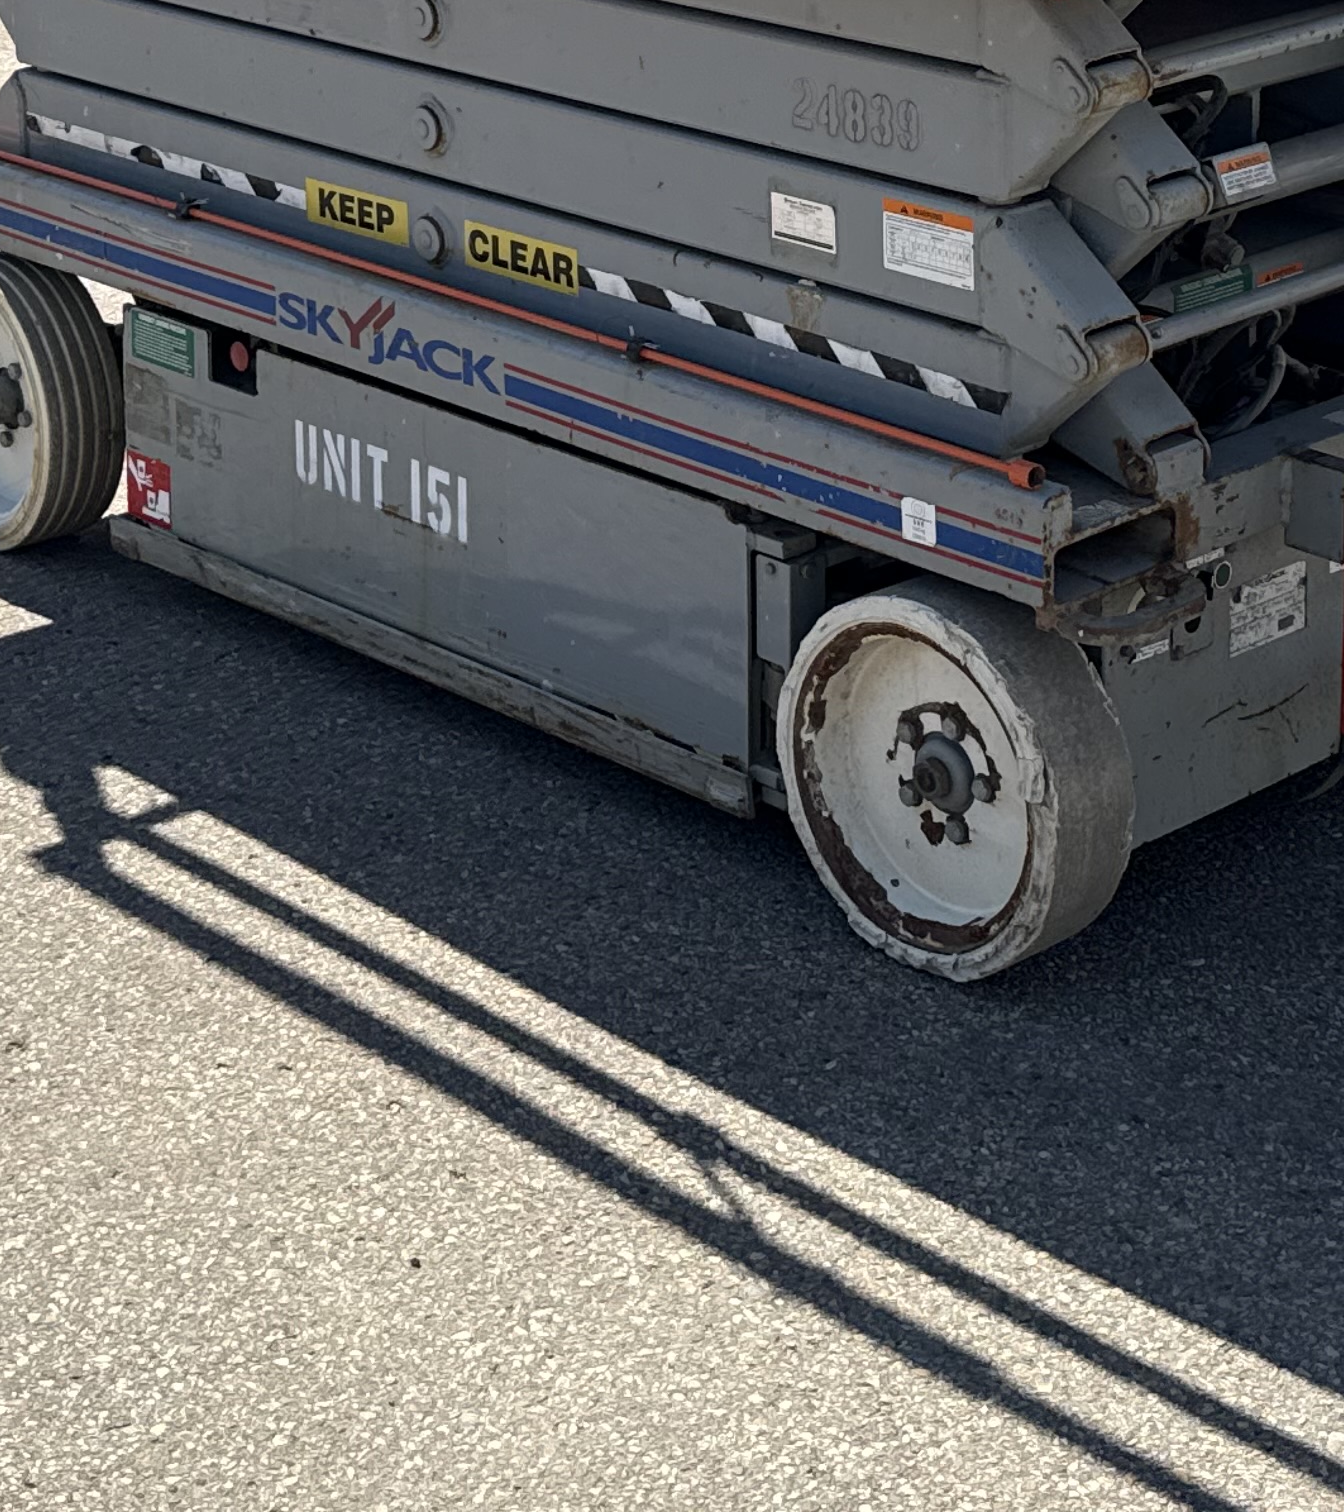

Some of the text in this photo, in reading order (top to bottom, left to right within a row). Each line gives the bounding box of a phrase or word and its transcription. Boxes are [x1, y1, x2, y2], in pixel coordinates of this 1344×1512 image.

[792, 77, 920, 152] 24839
[318, 187, 574, 288] KEEP CLEAR
[278, 296, 501, 396] SKYJACK
[295, 419, 467, 543] UNIT 151
